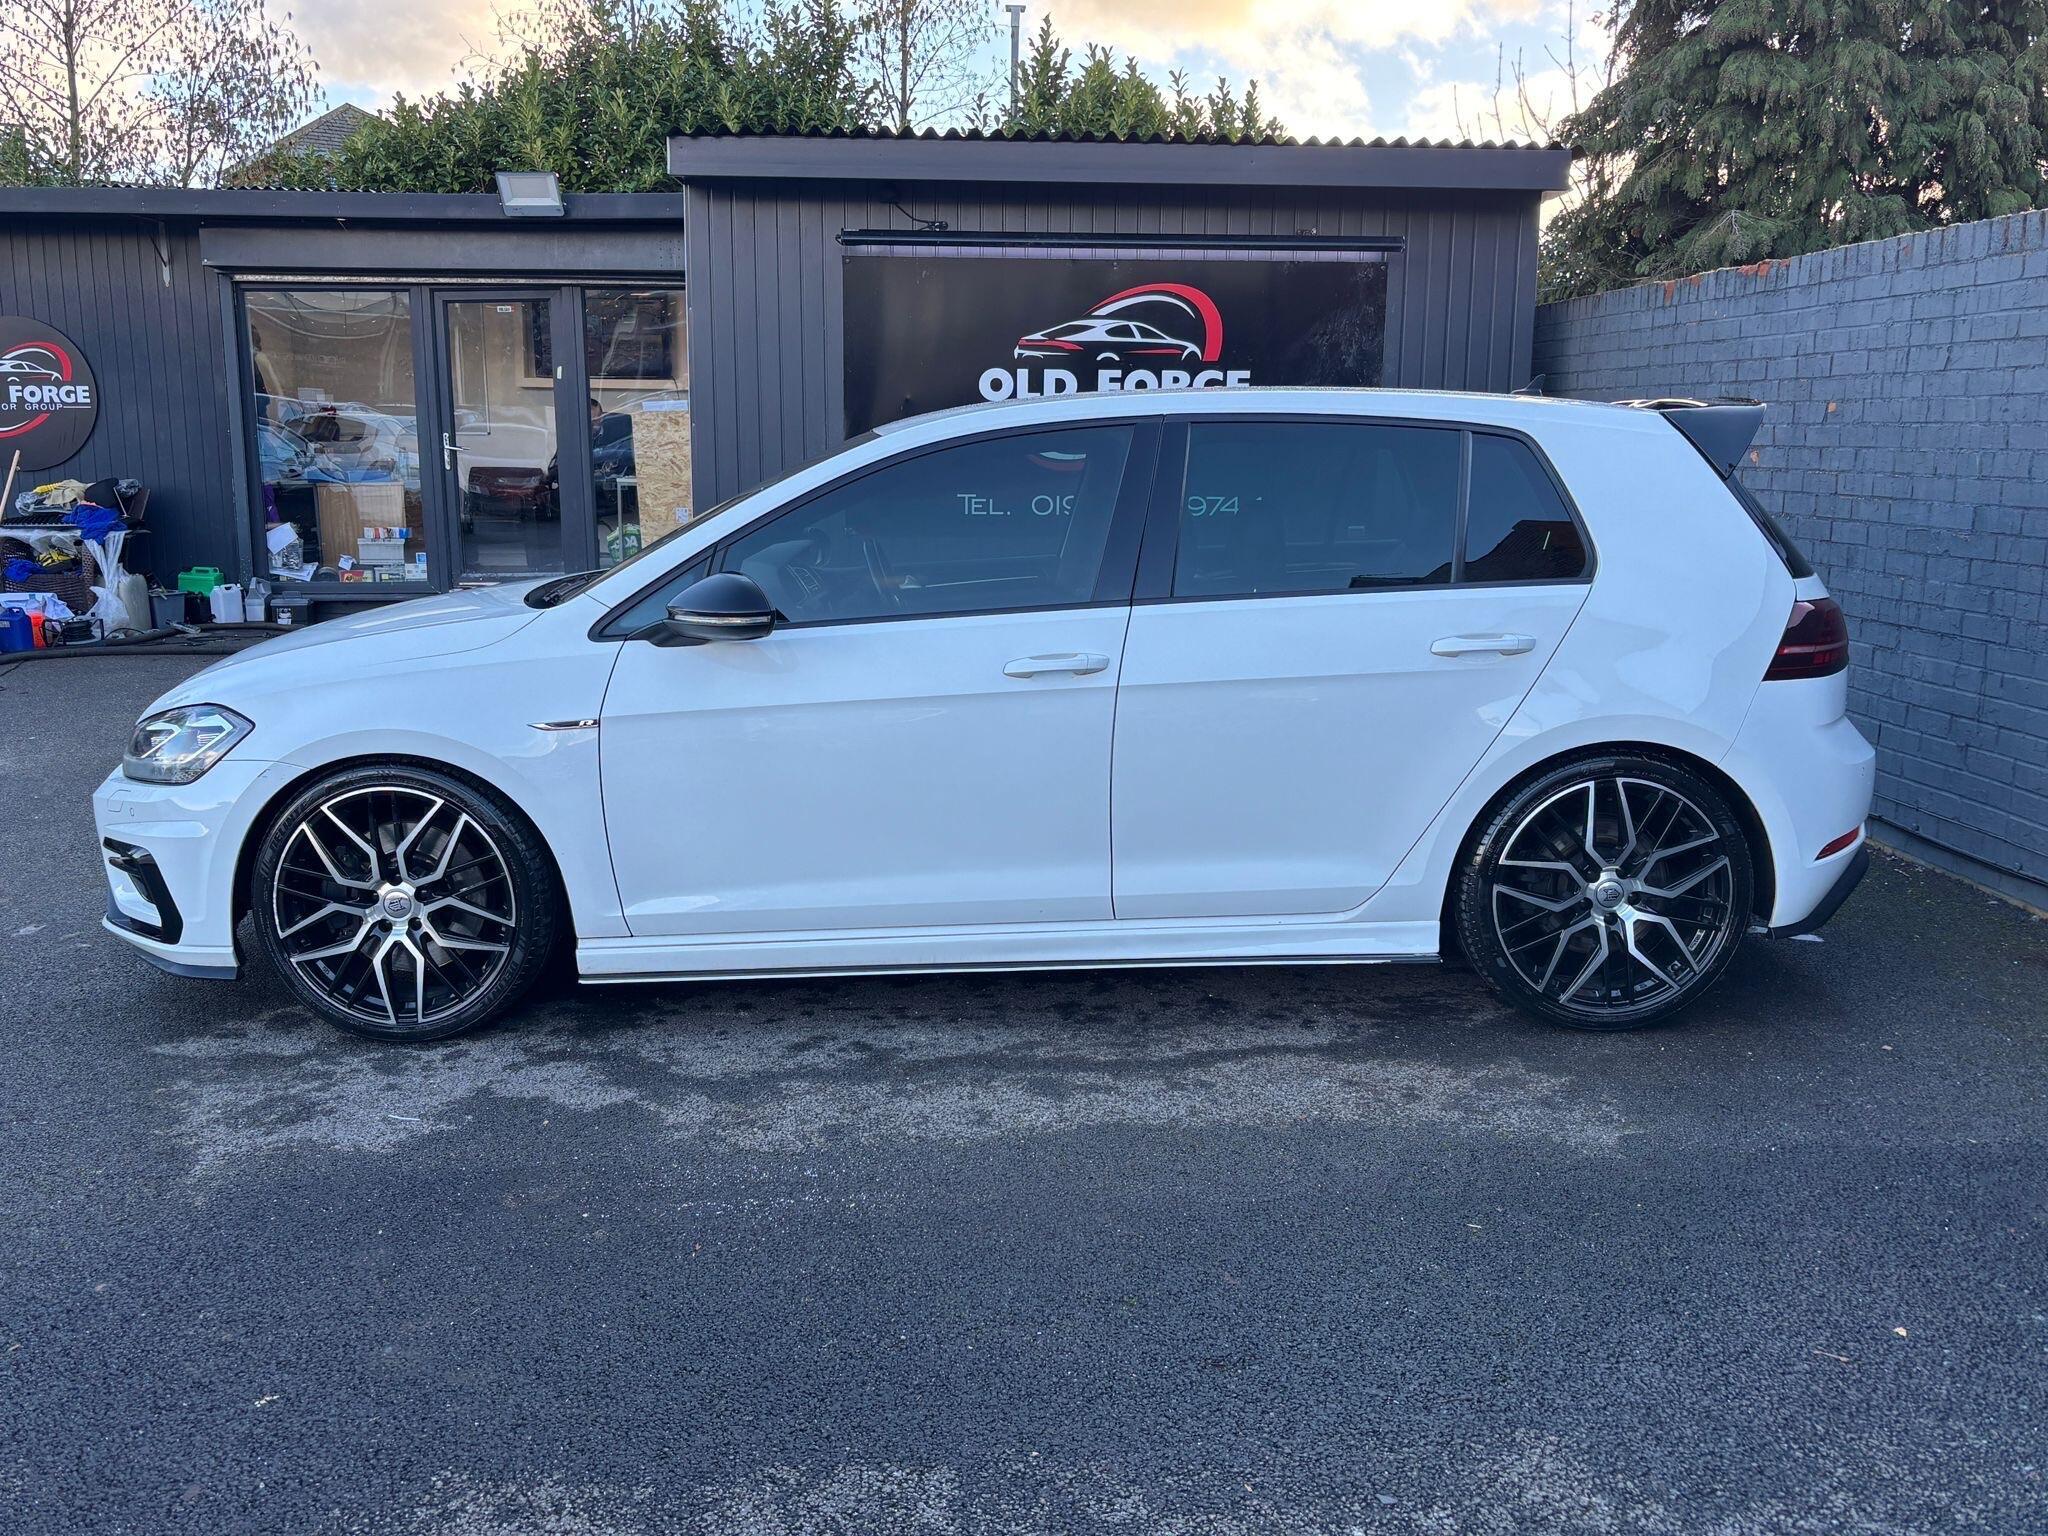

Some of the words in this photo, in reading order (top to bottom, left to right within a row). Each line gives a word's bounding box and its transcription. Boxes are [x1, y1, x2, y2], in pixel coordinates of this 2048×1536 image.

[978, 367, 1077, 402] OLD
[9, 385, 90, 403] FORGE
[25, 403, 63, 411] GROUP
